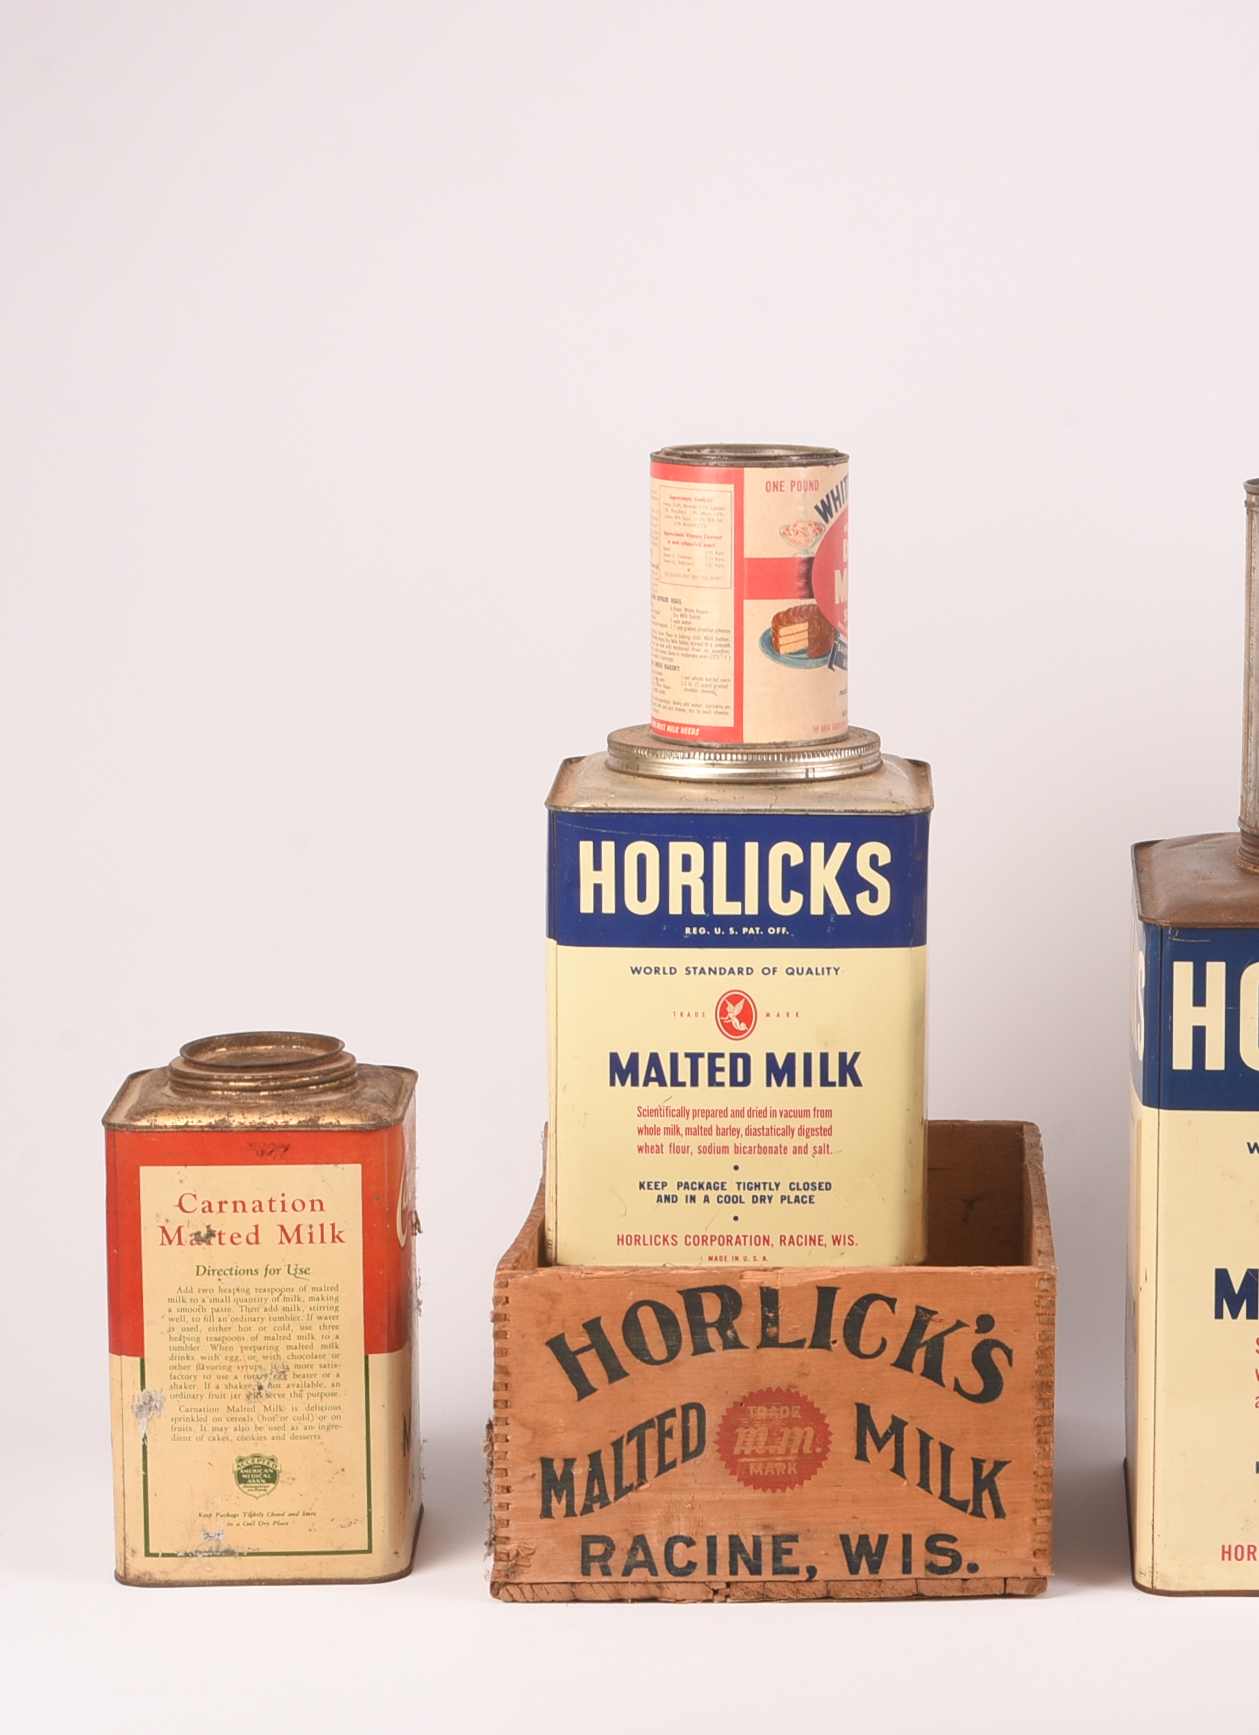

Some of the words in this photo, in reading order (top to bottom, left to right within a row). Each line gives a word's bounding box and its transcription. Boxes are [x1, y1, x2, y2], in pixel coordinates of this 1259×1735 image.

[766, 480, 785, 492] ONE
[790, 480, 819, 491] POUND
[579, 841, 891, 916] HORLICKS
[685, 927, 709, 935] REG.
[631, 967, 677, 975] WORLD
[685, 967, 753, 975] STANDARD
[762, 967, 777, 975] OF
[786, 967, 840, 975] QUALITY
[610, 1052, 751, 1087] MALTED
[766, 1052, 862, 1087] MILK
[637, 1105, 690, 1120] Scientifically
[692, 1107, 728, 1120] prepared
[731, 1107, 745, 1118] and
[747, 1107, 767, 1118] dried
[770, 1107, 777, 1118] in
[779, 1109, 810, 1118] vacuum
[813, 1107, 832, 1118] from
[637, 1124, 661, 1136] whole
[664, 1124, 683, 1137] milk,
[685, 1125, 712, 1136] malted
[716, 1125, 743, 1138] barley,
[745, 1125, 795, 1139] diastatically
[798, 1125, 832, 1139] digested
[637, 1143, 664, 1154] wheat
[669, 1143, 693, 1155] flour,
[698, 1143, 729, 1154] sodium
[734, 1143, 788, 1155] bicarbonate
[793, 1143, 808, 1154] and
[812, 1143, 832, 1155] salt.
[639, 1181, 667, 1190] KEEP
[677, 1182, 727, 1191] PACKAGE
[736, 1182, 780, 1191] TIGHTLY
[789, 1182, 831, 1191] CLOSED
[178, 1192, 326, 1213] Carnation
[657, 1195, 678, 1203] AND
[686, 1195, 696, 1203] IN
[703, 1195, 709, 1203] A
[717, 1195, 745, 1204] COOL
[752, 1195, 773, 1204] DRY
[781, 1195, 814, 1204] PLACE
[159, 1223, 261, 1246] Malted
[277, 1222, 346, 1245] Milk
[617, 1234, 678, 1246] HORLICKS
[685, 1235, 773, 1247] CORPORATION,
[780, 1235, 826, 1247] RACINE,
[832, 1235, 857, 1246] WIS.
[195, 1265, 259, 1276] Directions
[264, 1265, 281, 1277] for
[287, 1264, 310, 1276] Use
[177, 1286, 193, 1294] Add
[219, 1286, 250, 1296] heaping
[255, 1287, 294, 1296] teaspoons
[545, 1284, 1013, 1403] HORLICK'S
[746, 1405, 801, 1418] TRADE
[236, 1458, 278, 1469] ACCEPTED
[540, 1402, 706, 1518] MALTED
[855, 1402, 1011, 1519] MILK
[749, 1462, 797, 1475] MARK
[580, 1534, 817, 1581] RACINE,
[840, 1534, 979, 1575] WIS.
